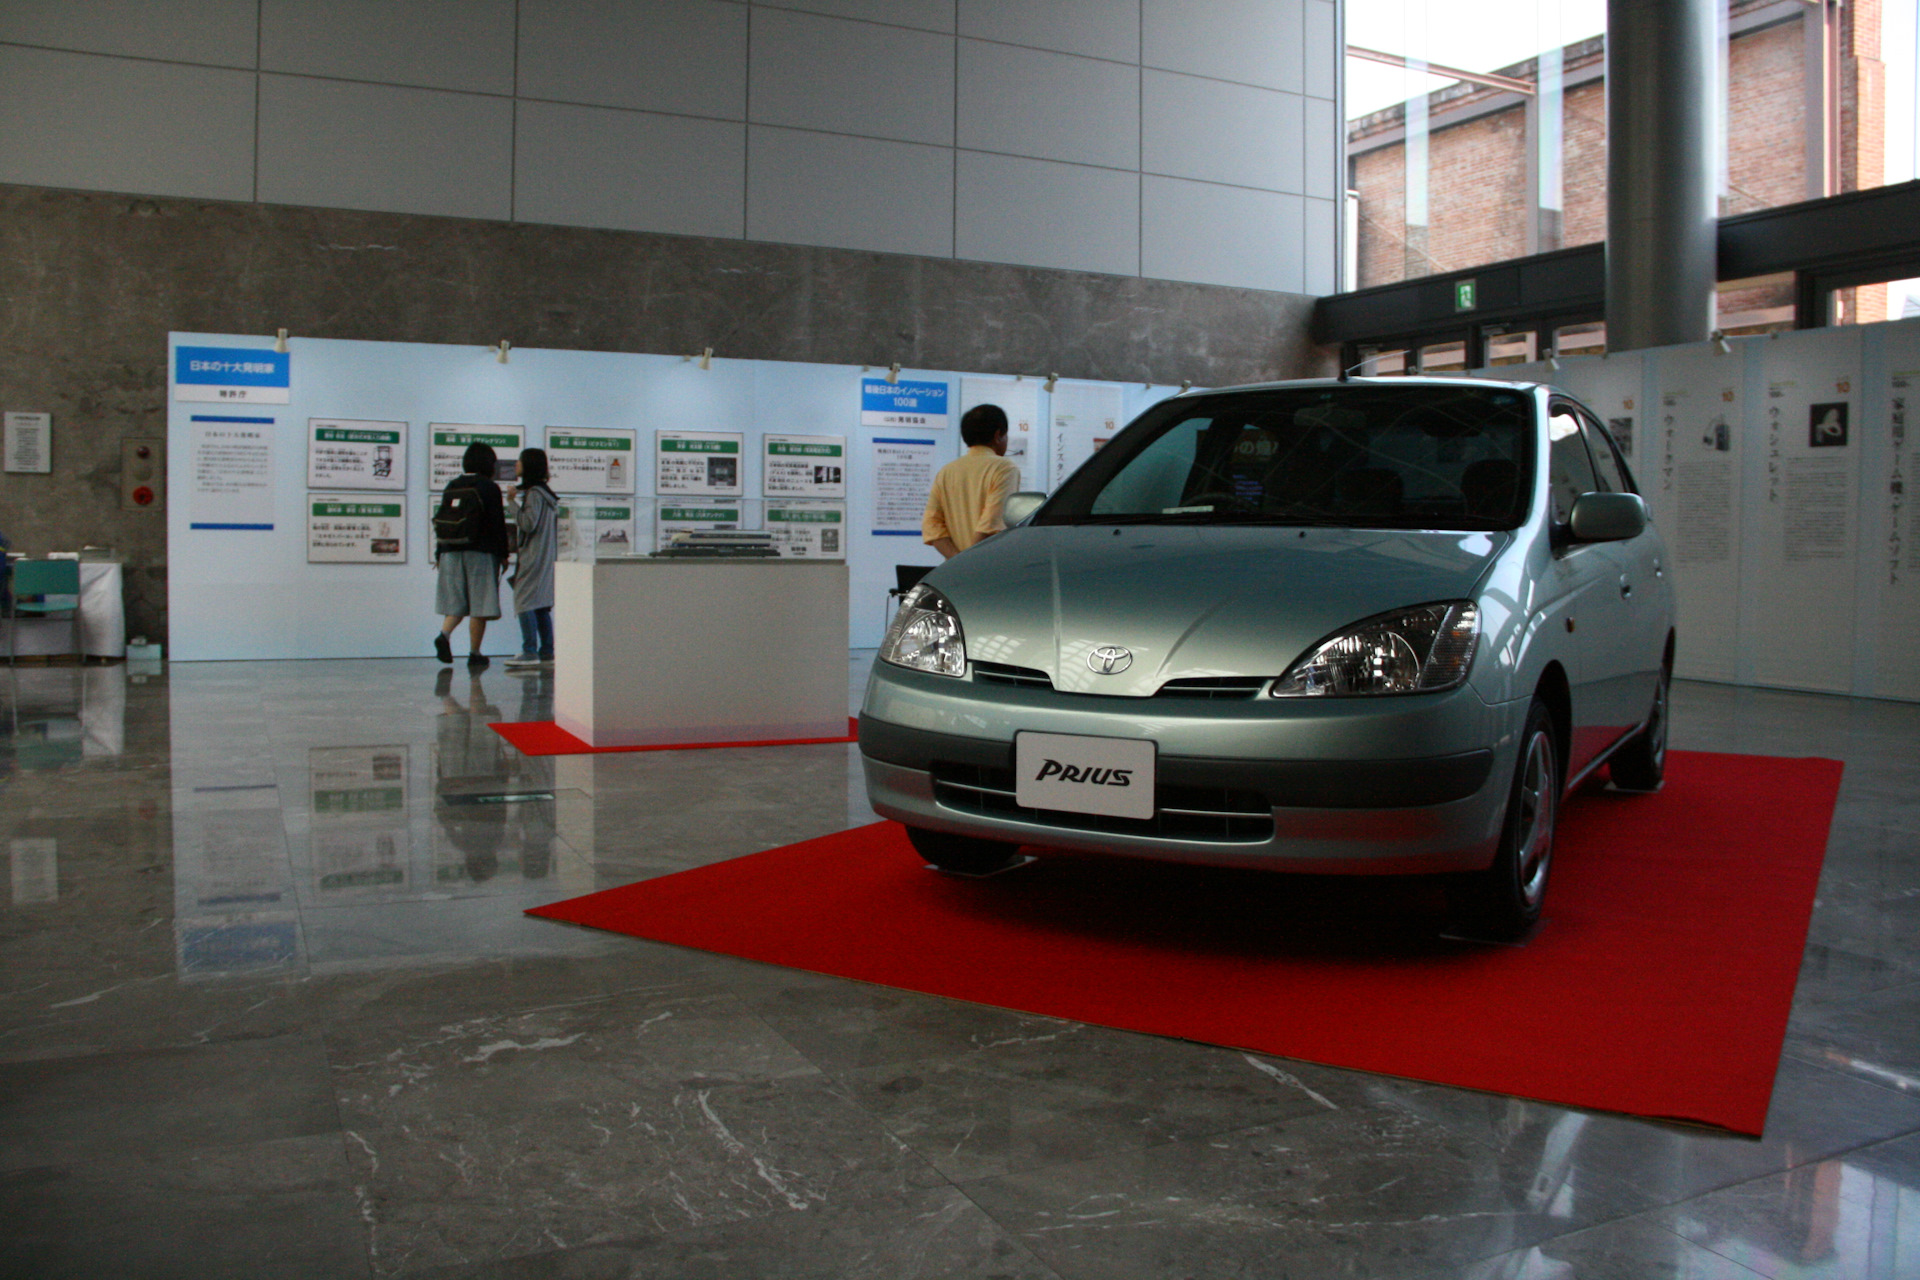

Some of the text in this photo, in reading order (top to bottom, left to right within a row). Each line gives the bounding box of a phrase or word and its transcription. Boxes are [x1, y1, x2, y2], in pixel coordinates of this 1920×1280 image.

[190, 360, 275, 374] 日本の十大発明家
[219, 389, 247, 398] 特許庁
[1056, 432, 1065, 487] インスタン
[1035, 758, 1133, 787] PRIUS
